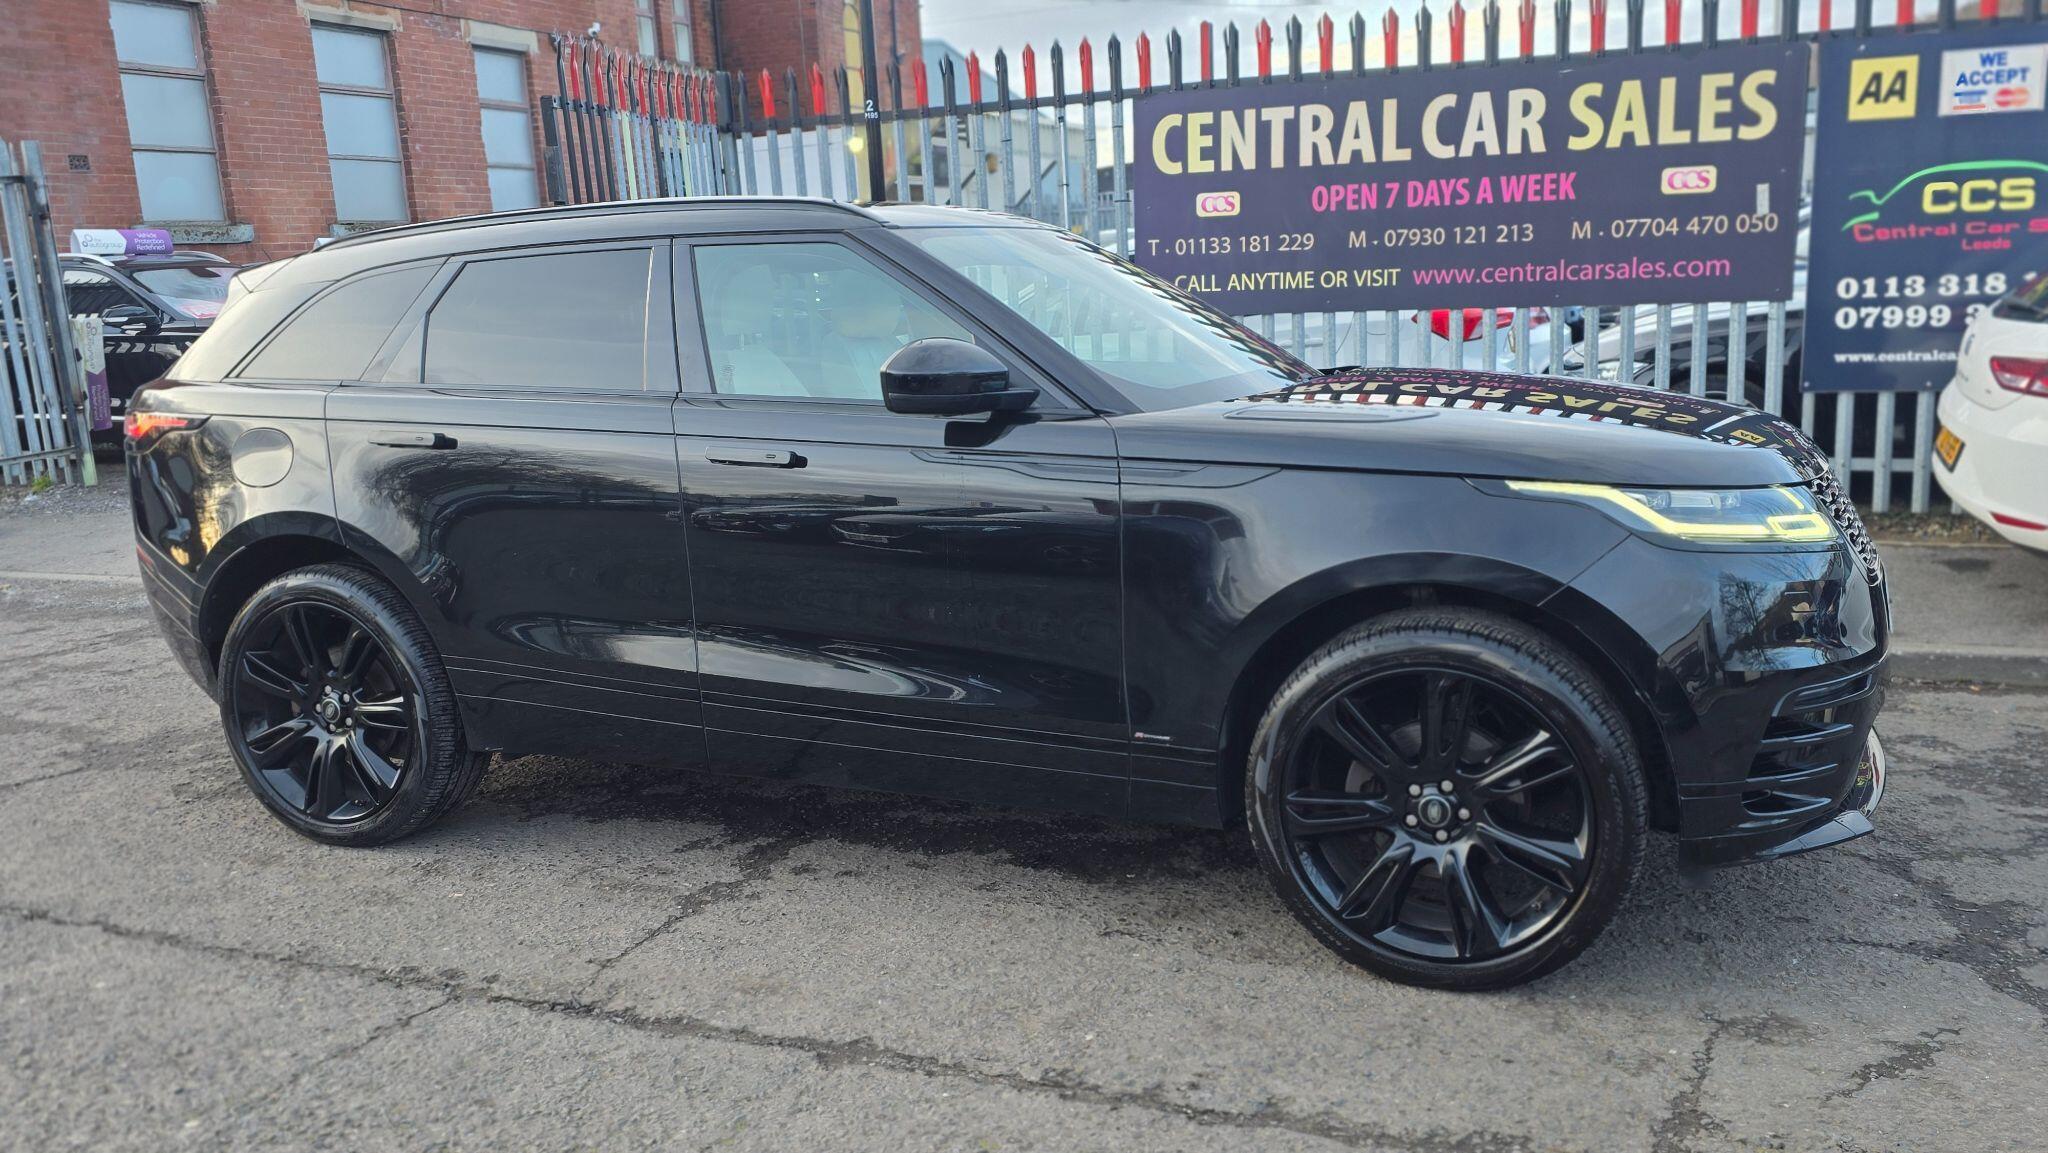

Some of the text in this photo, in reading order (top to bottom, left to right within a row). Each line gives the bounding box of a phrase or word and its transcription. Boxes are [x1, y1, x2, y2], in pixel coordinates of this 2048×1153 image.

[1980, 51, 2008, 67] WE
[1857, 70, 1908, 105] AA
[1956, 67, 2030, 86] ACCEPT
[866, 99, 874, 112] 2
[1152, 69, 1778, 175] CENTRAL CAR SALES
[1666, 169, 1711, 190] CCS
[1312, 172, 1577, 212] OPEN 7 DAYS A WEEK
[1922, 177, 2036, 214] CCS
[1201, 195, 1236, 214] CCS
[1348, 231, 1366, 249] M
[1384, 227, 1446, 248] 07930
[1454, 226, 1486, 245] 121
[1496, 223, 1534, 244] 213
[1572, 221, 1591, 240] M
[1611, 218, 1679, 239] 07704
[1686, 215, 1728, 236] 470
[1736, 213, 1779, 234] 050
[1853, 222, 1957, 242] Central
[1965, 221, 2020, 235] Car
[1148, 239, 1160, 256] T
[1175, 237, 1231, 256] 01133
[1239, 235, 1270, 254] 181
[1278, 233, 1315, 252] 229
[1961, 238, 2012, 250] Leeds
[1174, 257, 1731, 294] CALL ANYTIME OR VISIT www.centralcarsales.com
[1836, 275, 1926, 299] 0113
[1938, 272, 2007, 296] 318
[1834, 304, 1952, 329] 07999
[1833, 350, 1959, 363] www.centralca
